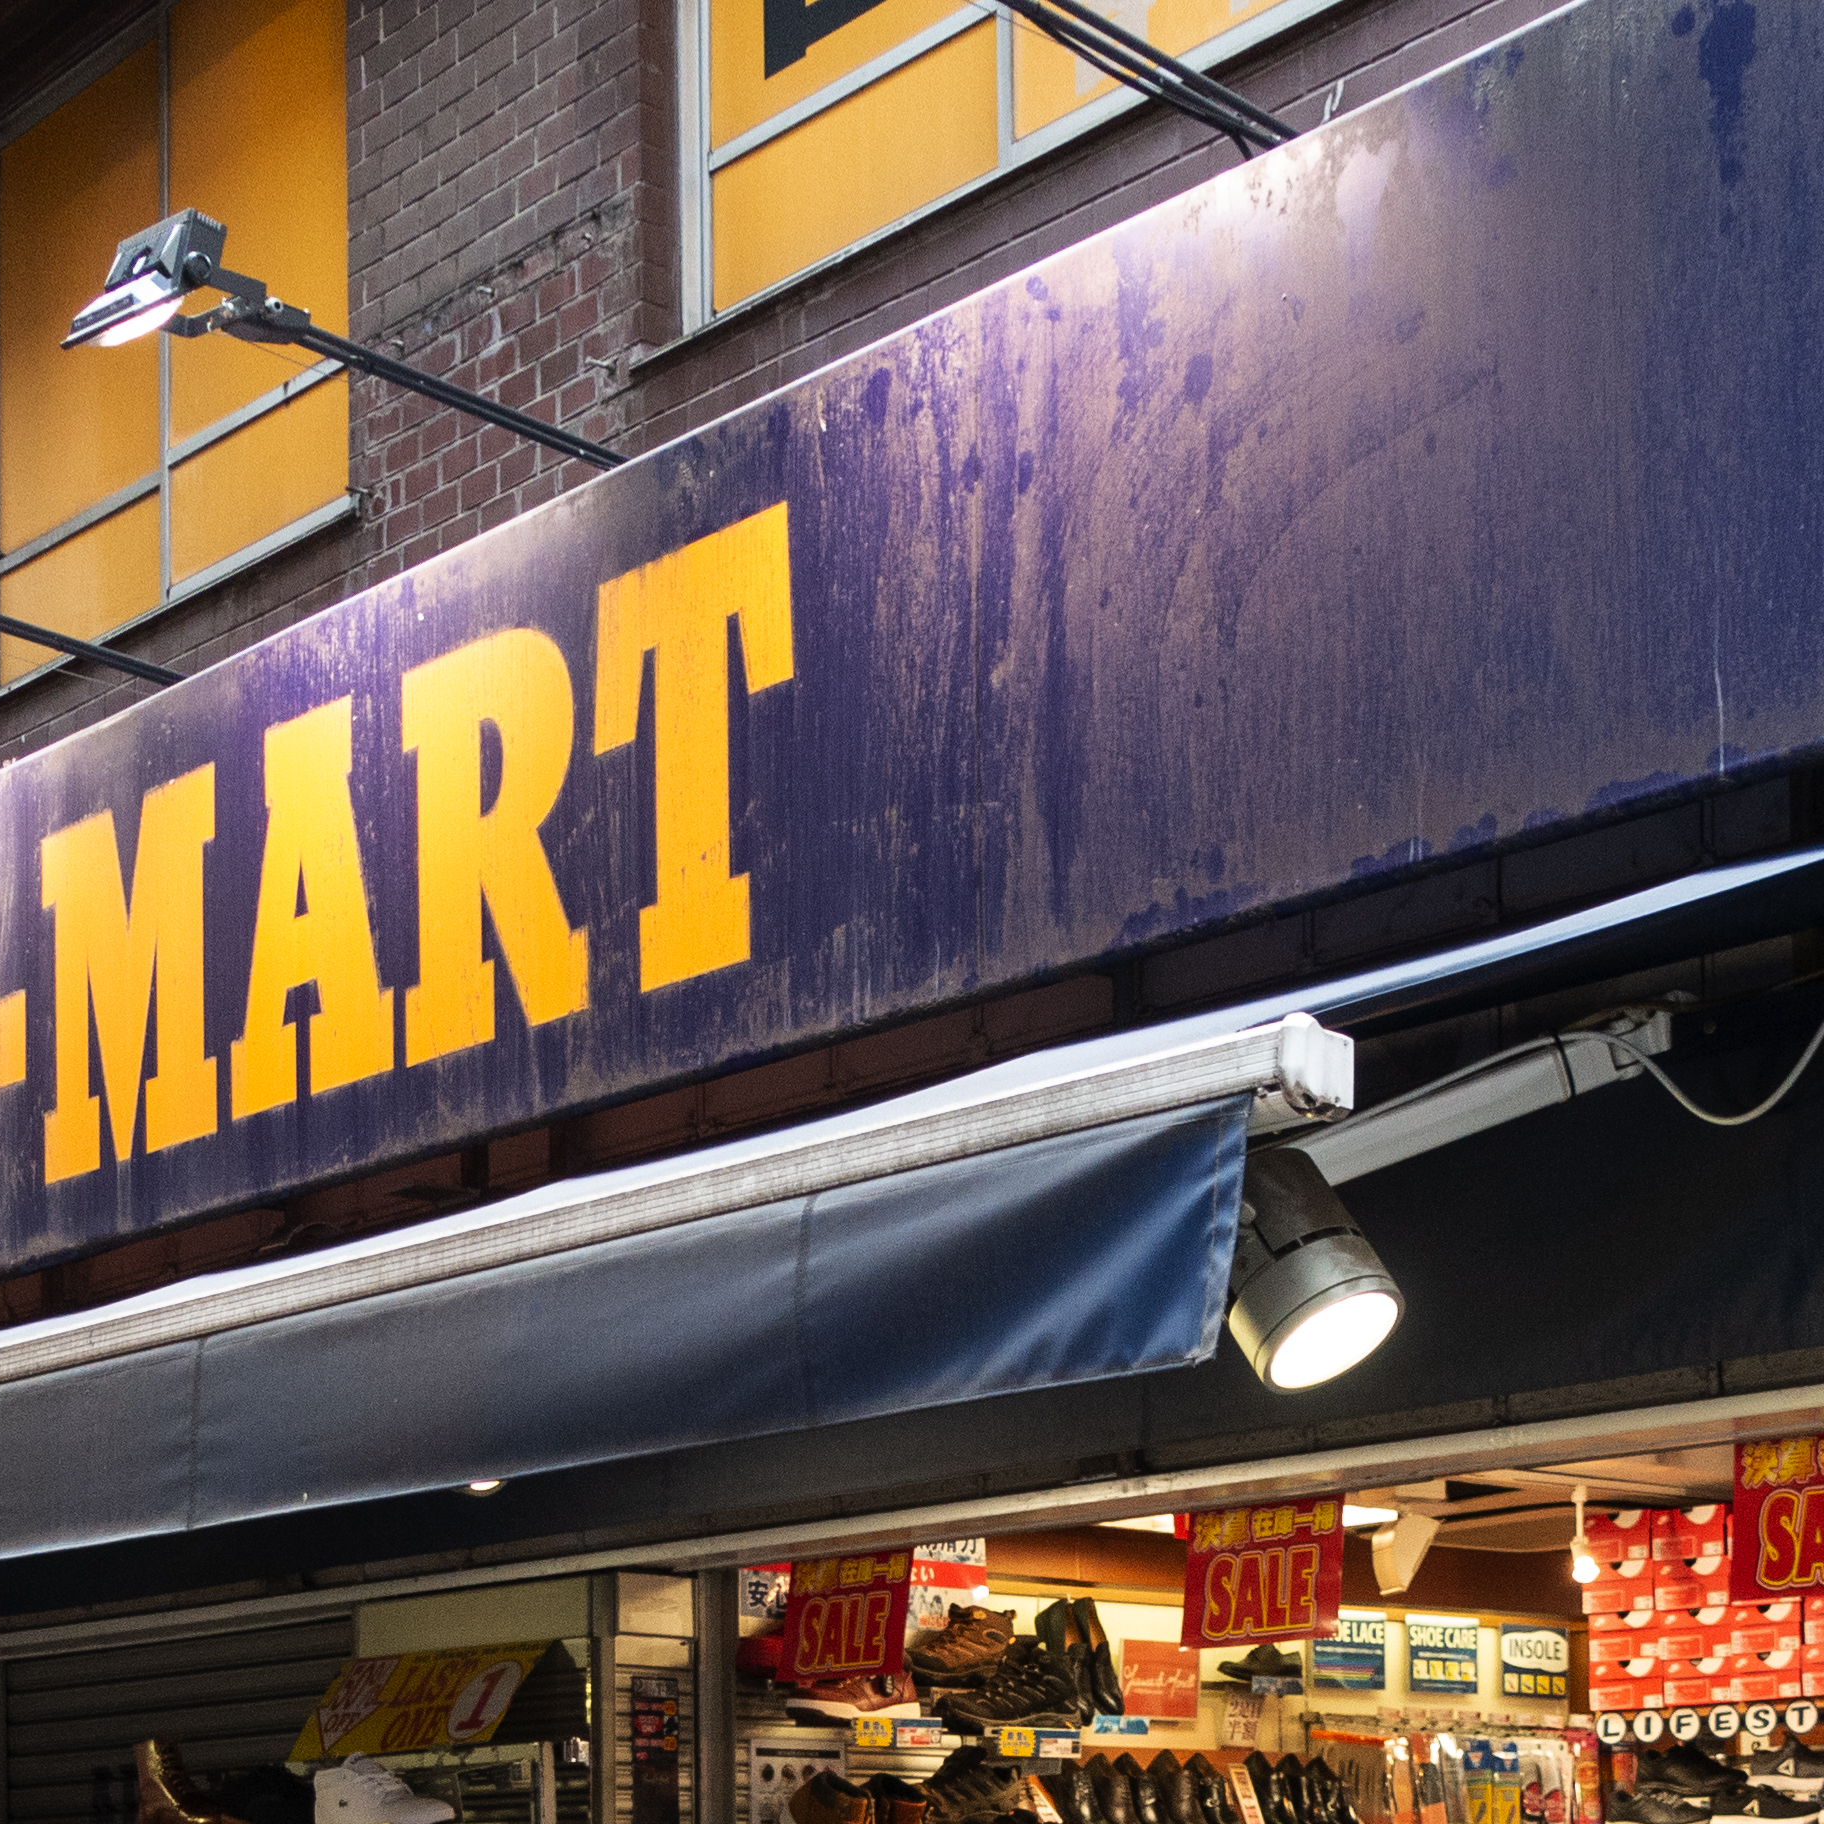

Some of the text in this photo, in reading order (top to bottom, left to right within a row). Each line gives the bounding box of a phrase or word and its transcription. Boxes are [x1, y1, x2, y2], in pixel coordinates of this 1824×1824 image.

[1743, 1437, 1815, 1484] 決算
[1193, 1510, 1249, 1551] 決算
[1203, 1546, 1317, 1638] SALE
[797, 1593, 891, 1670] SALE
[1409, 1625, 1477, 1648] SHOE CARE
[1508, 1638, 1563, 1664] INSOLE
[387, 1659, 478, 1708] LAST
[380, 1706, 450, 1751] ONE
